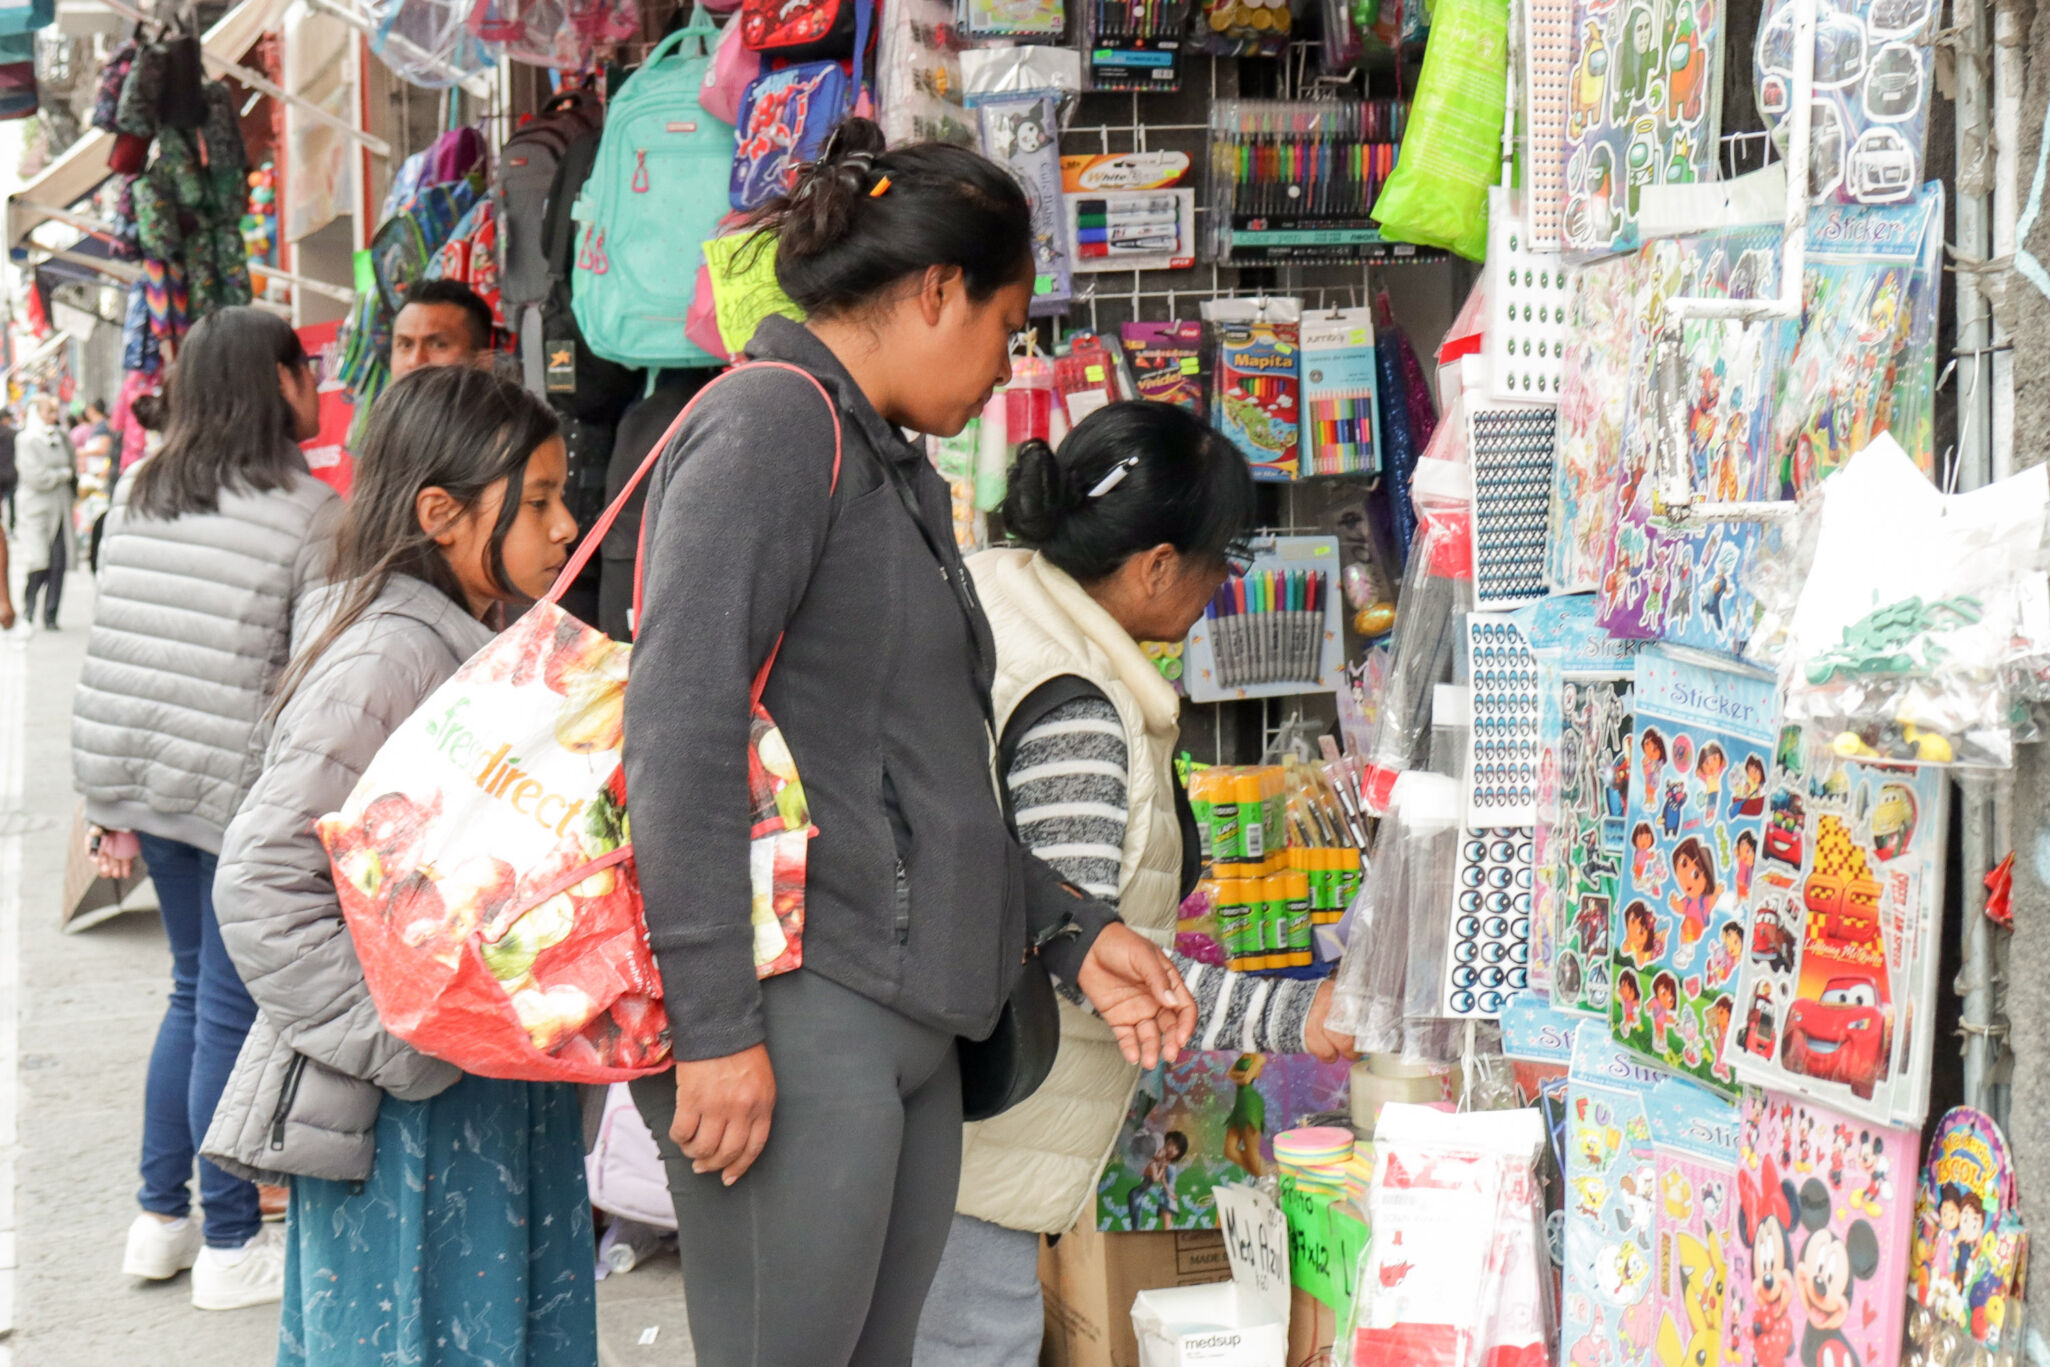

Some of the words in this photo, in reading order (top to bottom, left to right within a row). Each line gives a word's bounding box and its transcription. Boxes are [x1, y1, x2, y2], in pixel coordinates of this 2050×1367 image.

[1825, 211, 1904, 241] Sticker
[1233, 353, 1293, 370] Mapita
[1670, 682, 1755, 721] Sticker
[1190, 1252, 1220, 1265] MADE
[1185, 1334, 1241, 1349] medsup
